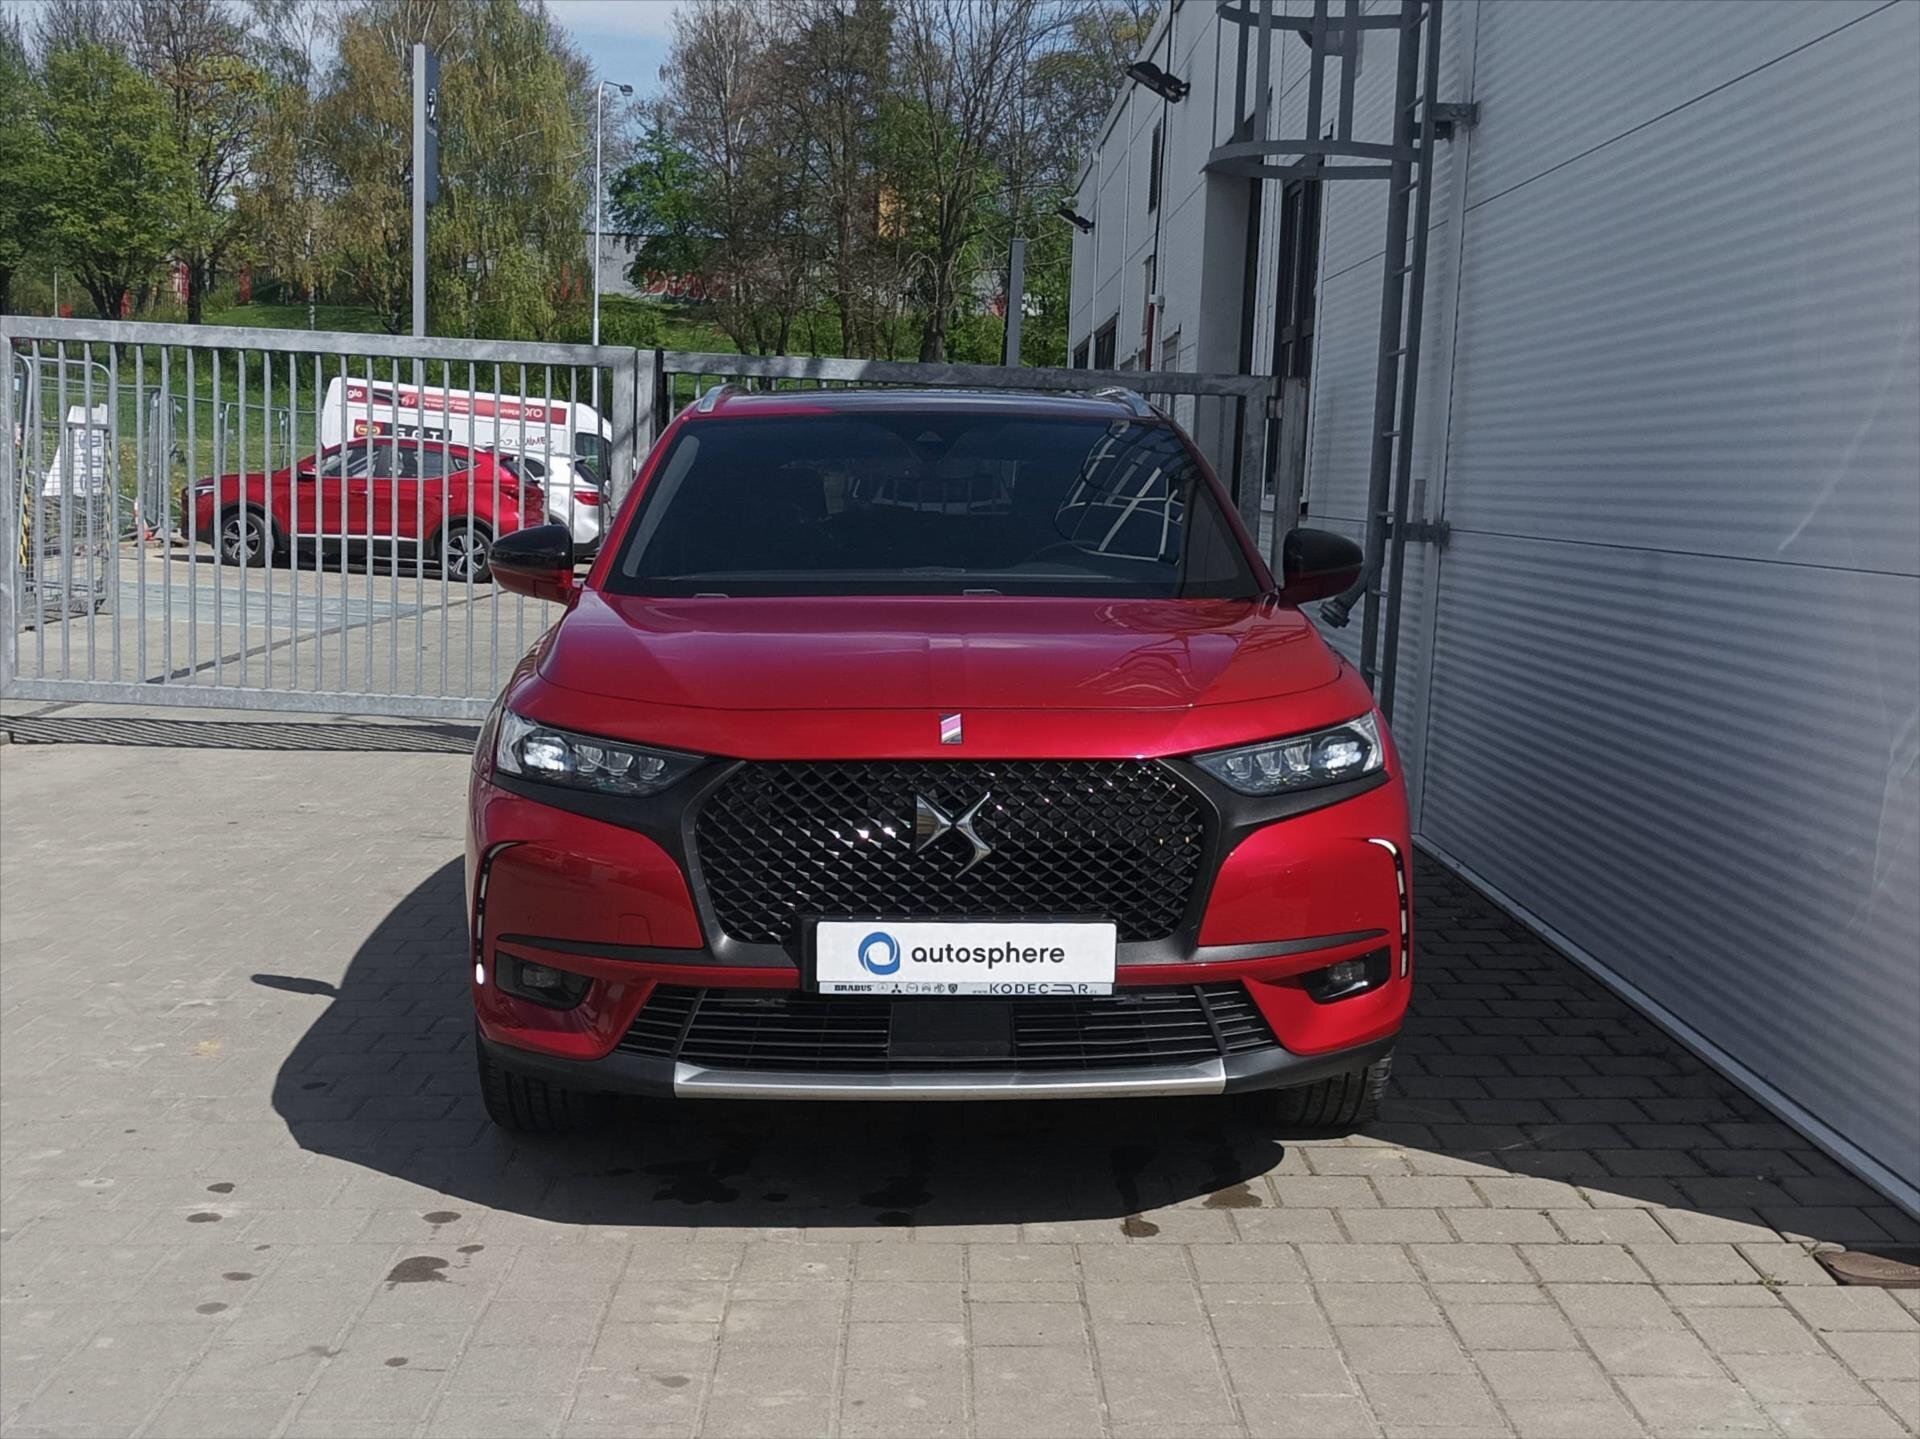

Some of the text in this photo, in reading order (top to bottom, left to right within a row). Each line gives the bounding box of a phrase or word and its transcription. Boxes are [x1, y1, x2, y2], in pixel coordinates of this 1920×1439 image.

[347, 388, 363, 399] glo
[911, 942, 1065, 969] autosphere
[834, 984, 873, 992] BRABUS
